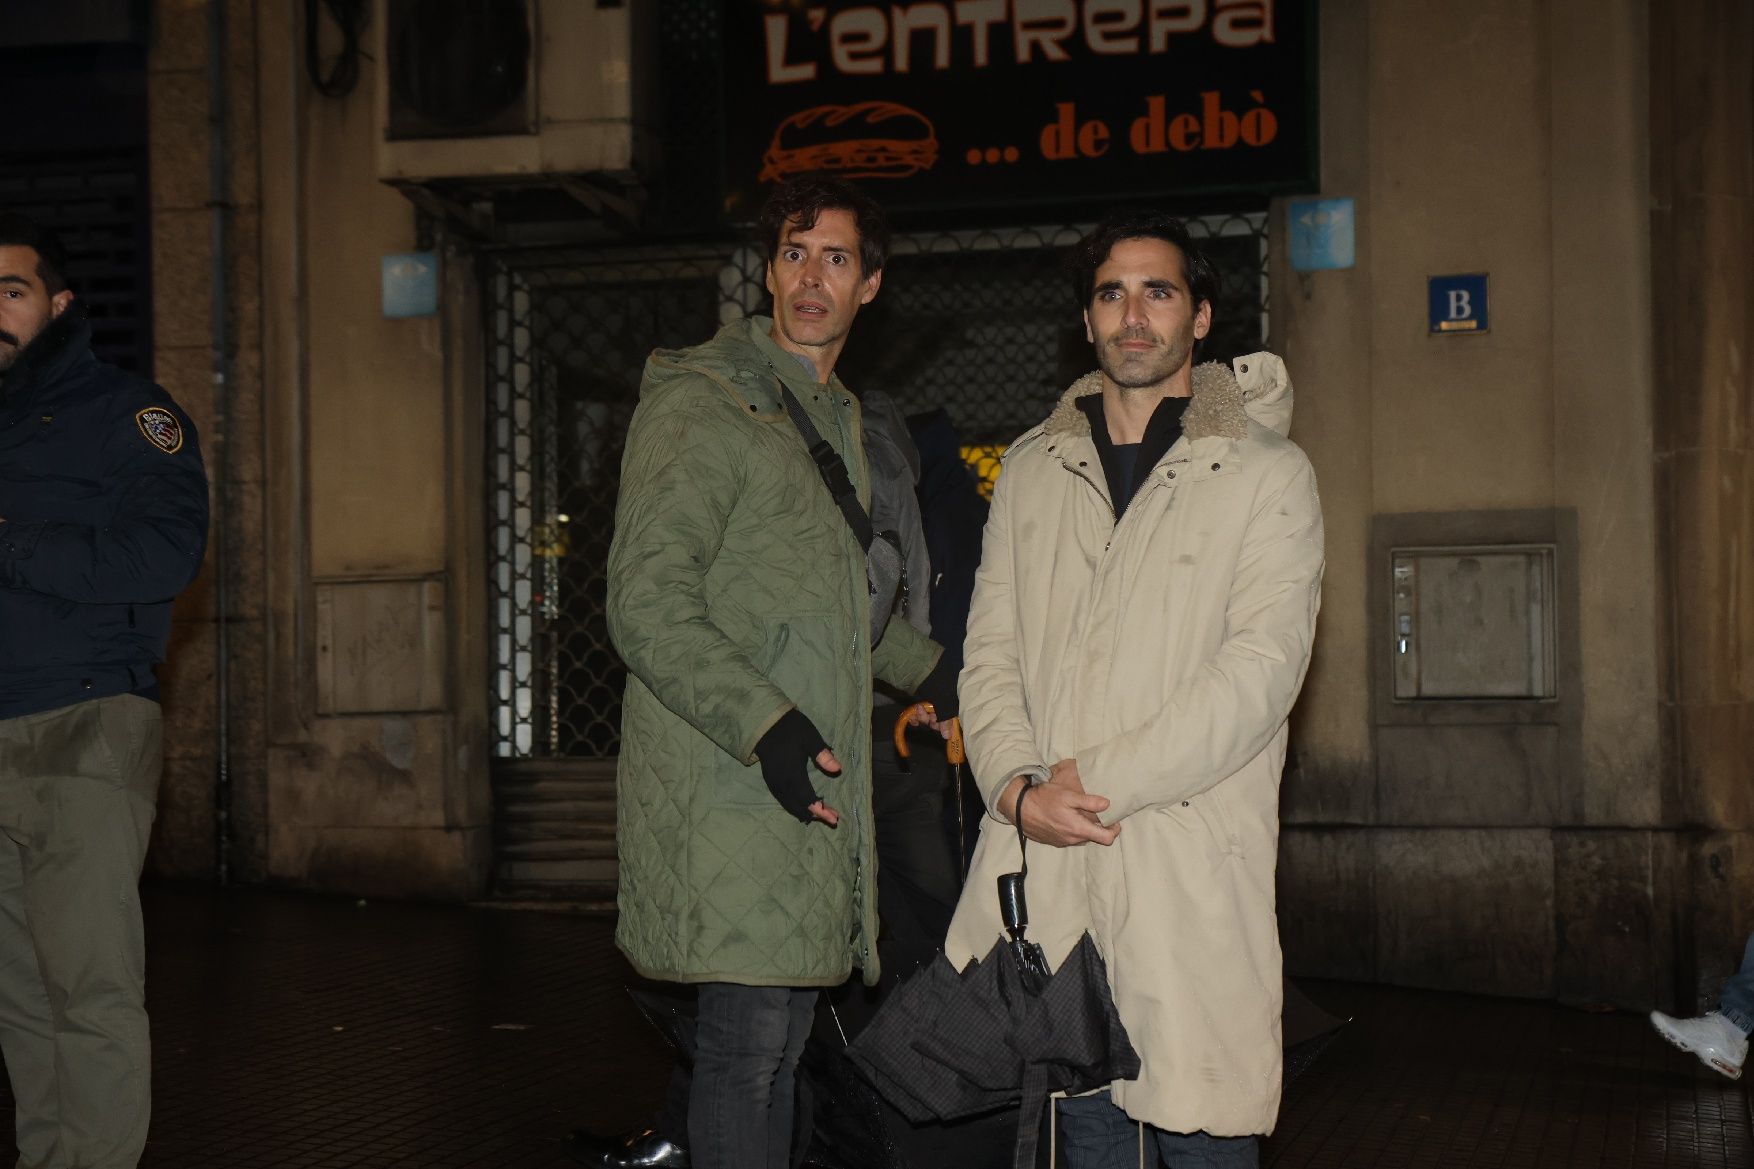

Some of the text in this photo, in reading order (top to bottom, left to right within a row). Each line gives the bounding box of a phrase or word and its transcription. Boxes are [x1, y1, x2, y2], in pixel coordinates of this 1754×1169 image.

[1039, 101, 1111, 160] de
[1128, 89, 1278, 155] debò
[1447, 289, 1472, 320] B
